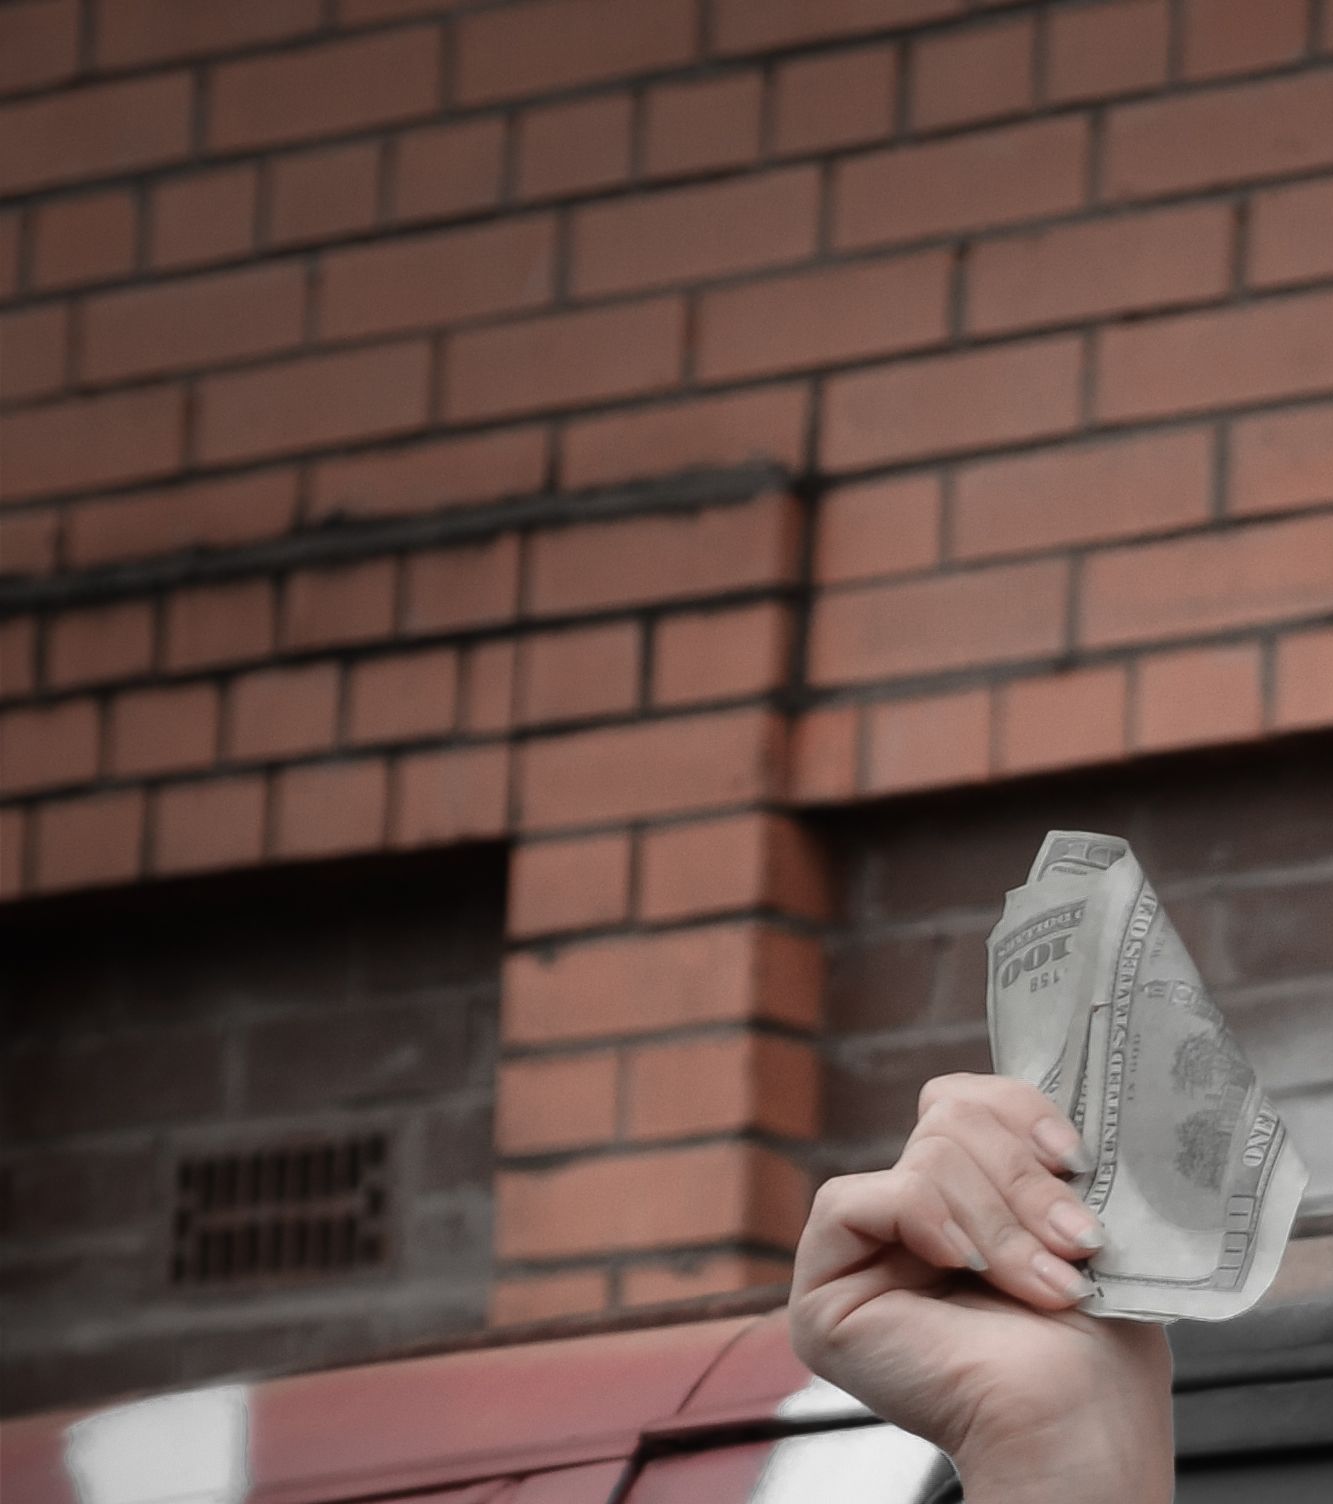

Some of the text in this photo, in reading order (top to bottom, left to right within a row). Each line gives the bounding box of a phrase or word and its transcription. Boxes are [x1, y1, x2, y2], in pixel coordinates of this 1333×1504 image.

[1001, 934, 1072, 989] 100
[1112, 940, 1144, 1048] STATES
[1102, 1051, 1124, 1161] UNITED
[1242, 1112, 1277, 1167] ONE
